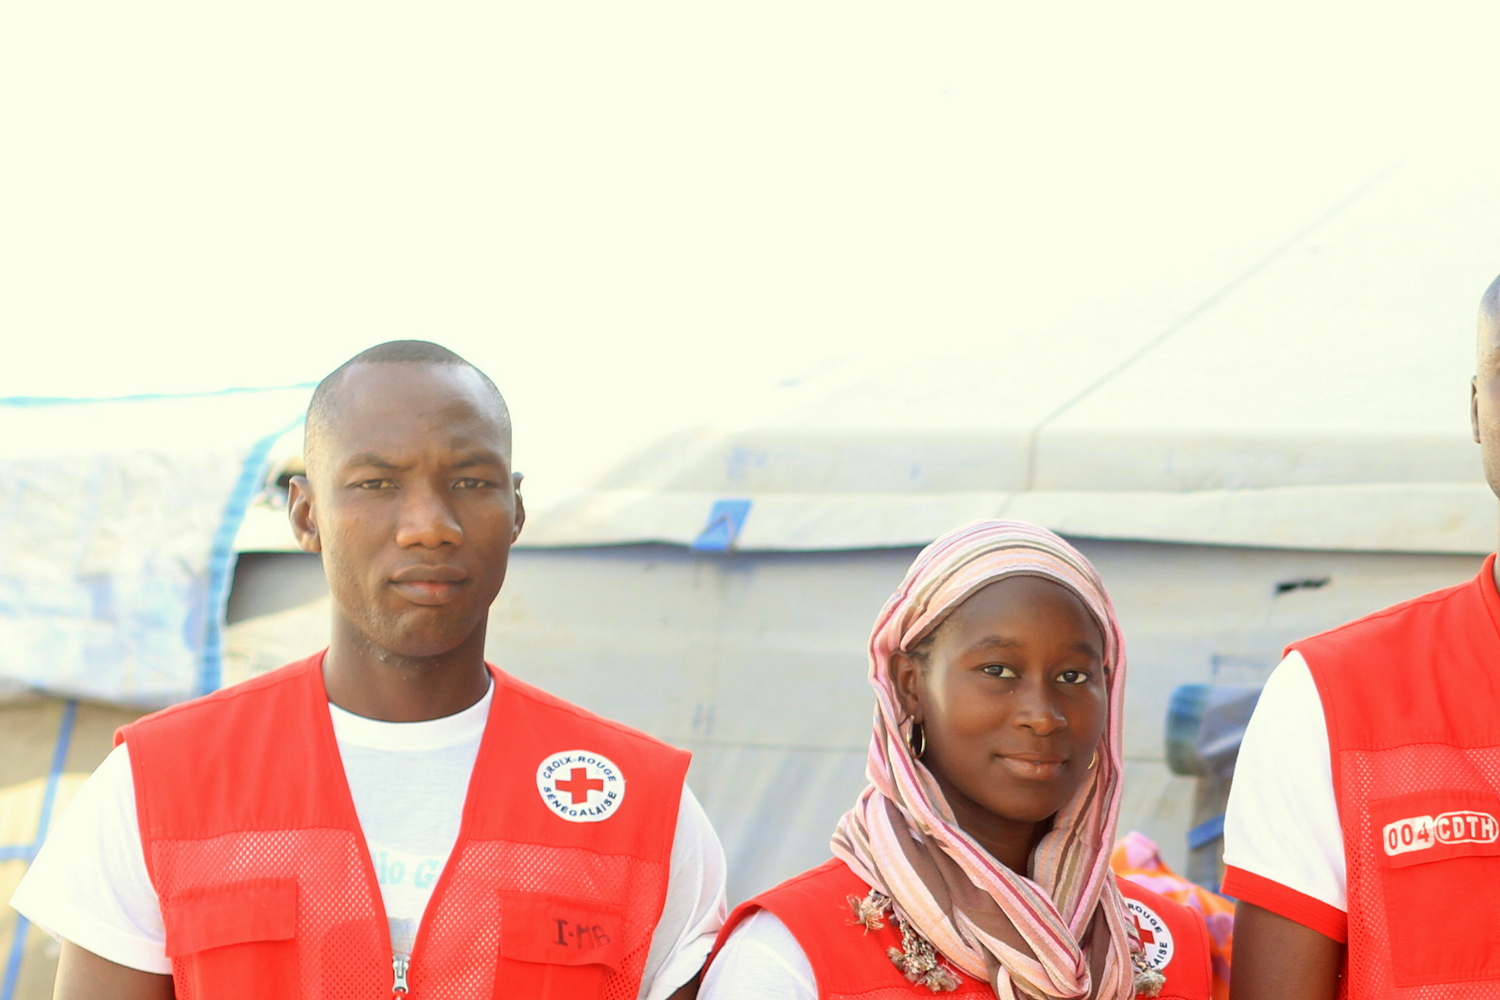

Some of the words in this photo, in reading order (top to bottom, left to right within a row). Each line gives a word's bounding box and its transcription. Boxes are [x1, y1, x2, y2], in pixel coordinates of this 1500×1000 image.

[543, 756, 617, 782] CROIX-ROUGE
[1388, 822, 1430, 850] 004
[1438, 816, 1495, 839] CDTH
